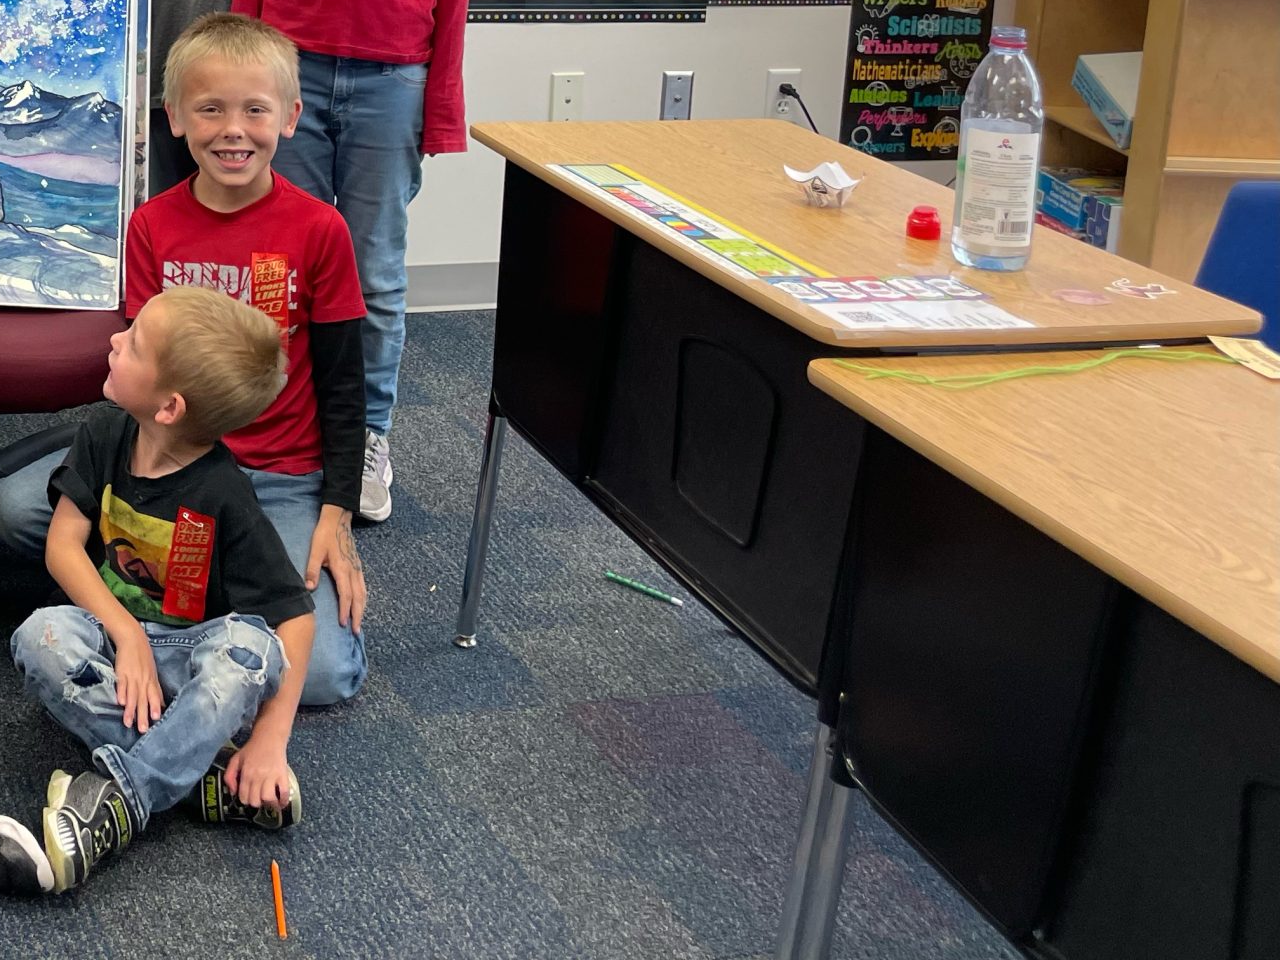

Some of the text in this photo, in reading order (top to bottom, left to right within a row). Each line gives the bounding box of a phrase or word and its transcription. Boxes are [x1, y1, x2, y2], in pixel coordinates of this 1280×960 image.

[888, 15, 982, 36] Scientists
[864, 38, 938, 54] Thinkers
[852, 59, 942, 80] Mathematicians
[255, 260, 285, 274] DRUG
[255, 270, 284, 283] FREE
[255, 282, 286, 292] LOOKS
[255, 289, 284, 301] LIKE
[175, 532, 210, 544] FREE
[173, 553, 206, 563] LIKE
[170, 565, 203, 578] ME
